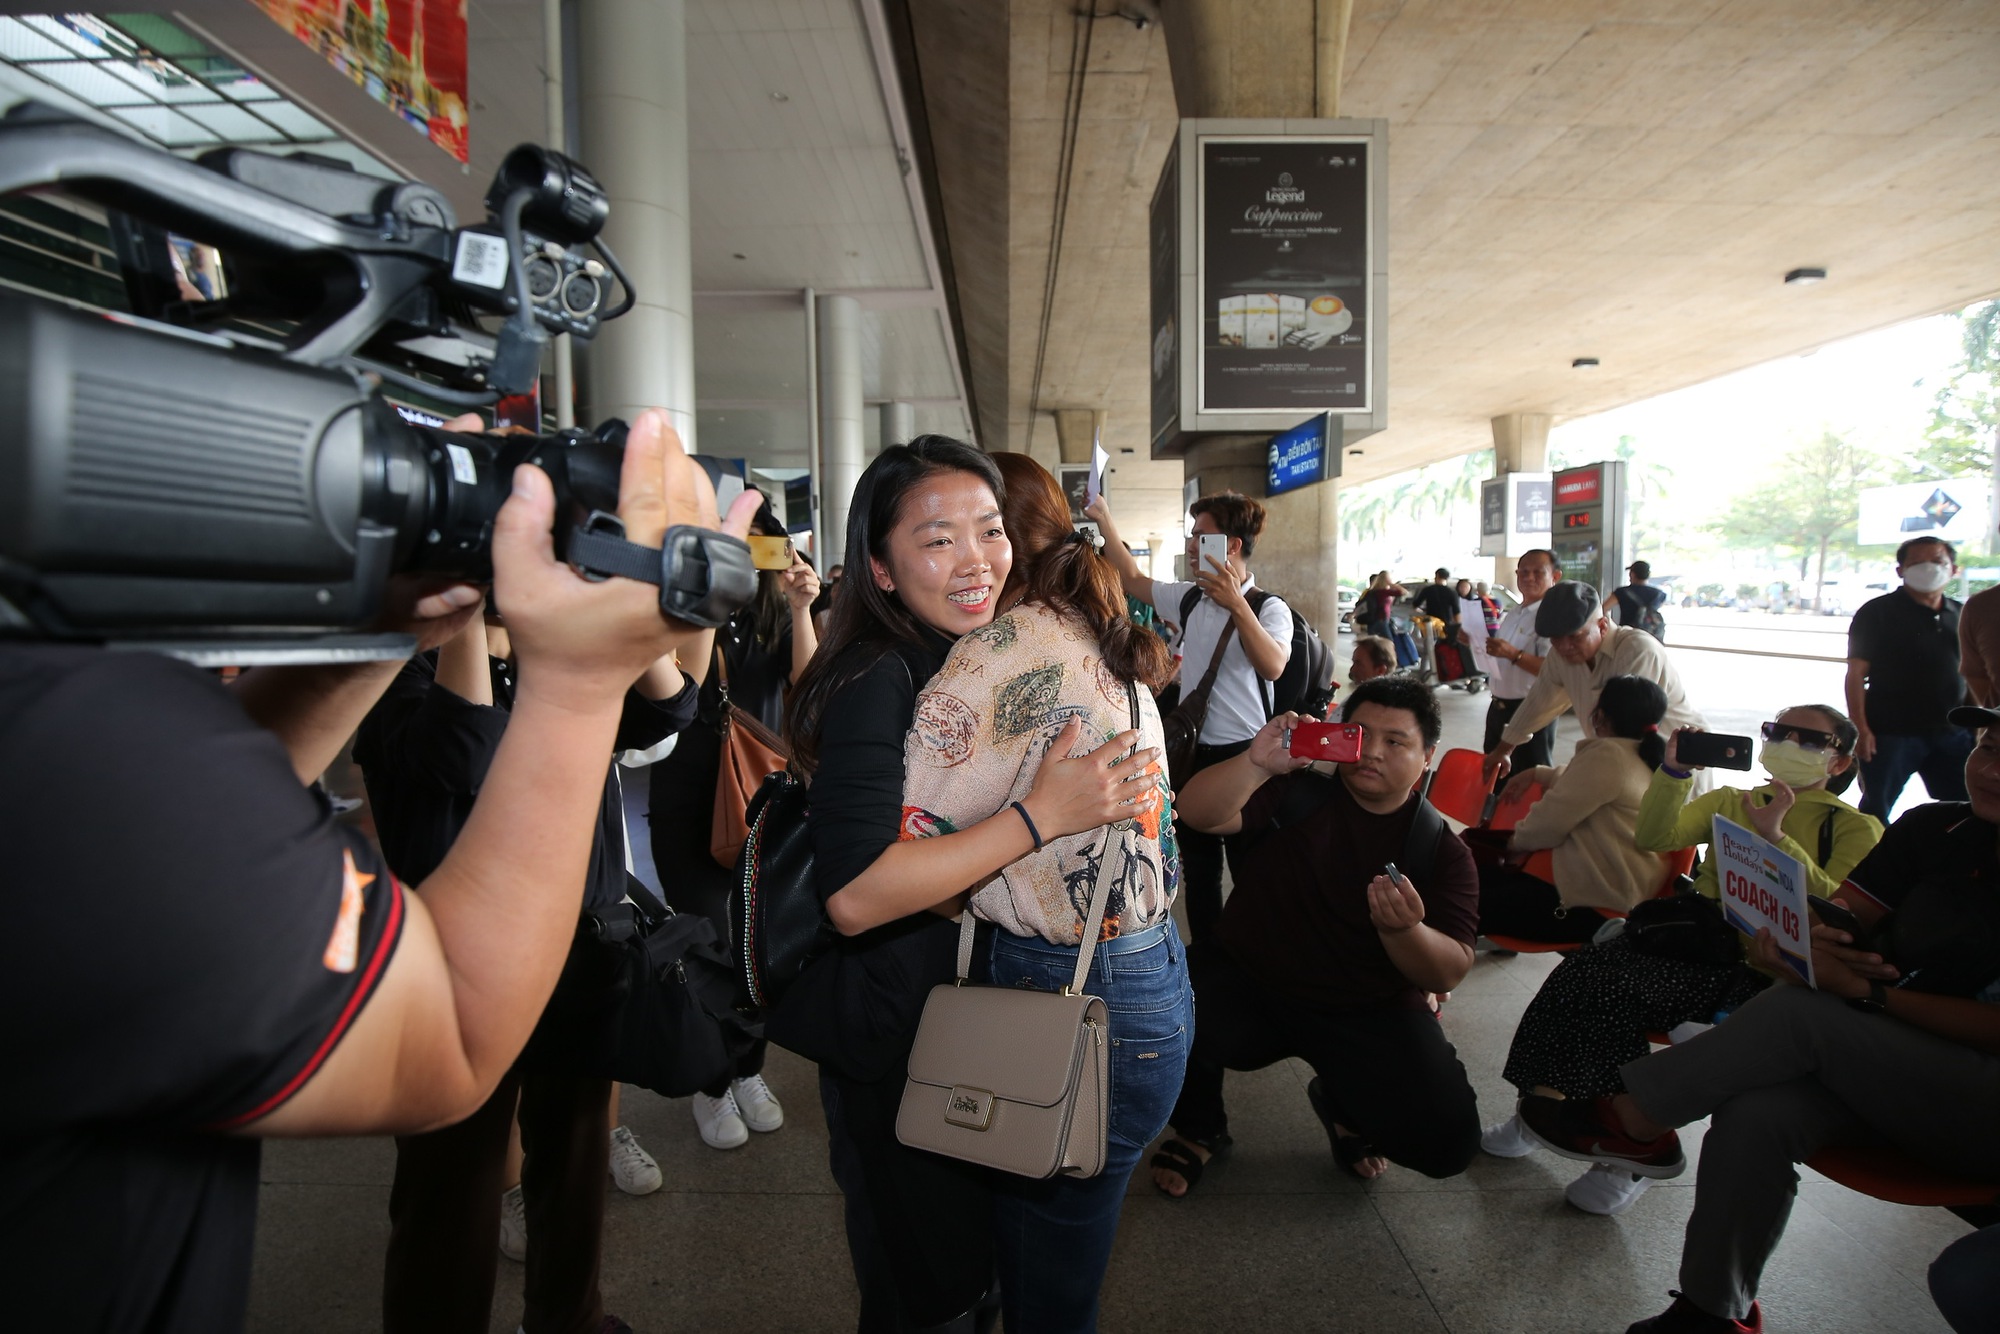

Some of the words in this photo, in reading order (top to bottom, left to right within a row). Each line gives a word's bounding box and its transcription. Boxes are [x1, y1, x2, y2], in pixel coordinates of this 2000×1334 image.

[1265, 190, 1305, 204] Legend
[1244, 205, 1323, 227] Cappuccino
[1778, 869, 1795, 895] INDIA
[1726, 869, 1778, 924] COACH
[1782, 905, 1799, 943] 03
